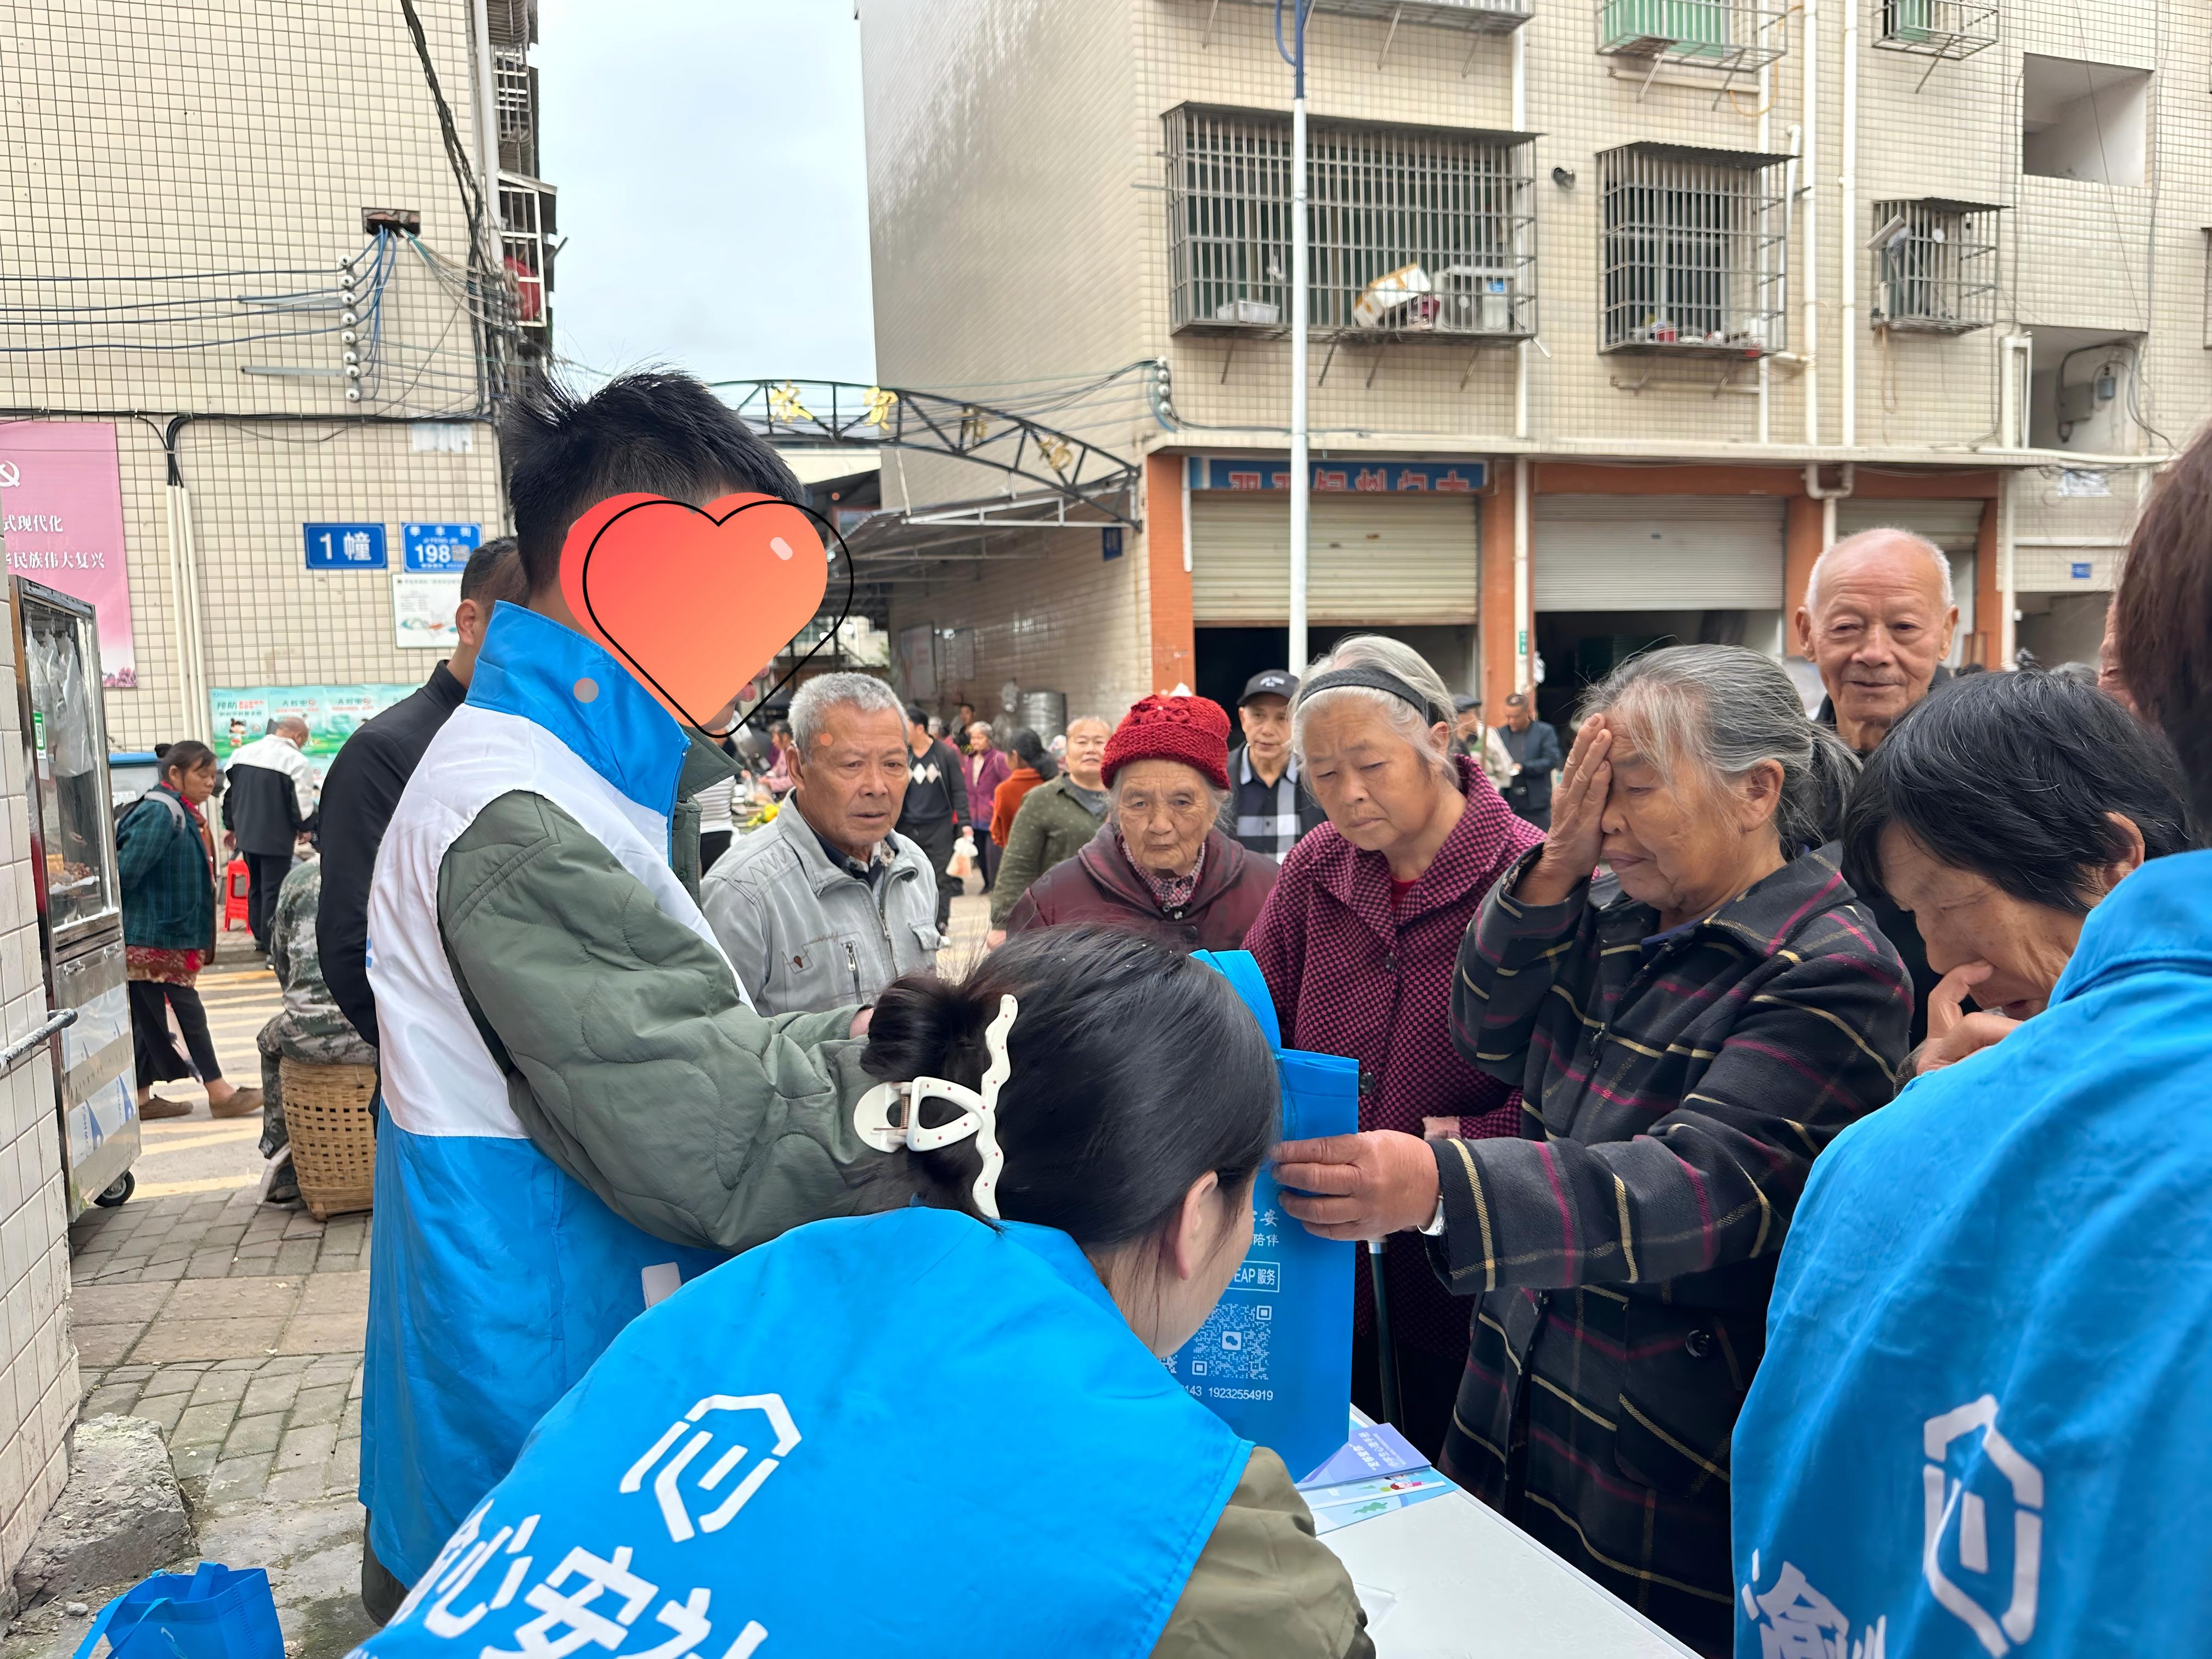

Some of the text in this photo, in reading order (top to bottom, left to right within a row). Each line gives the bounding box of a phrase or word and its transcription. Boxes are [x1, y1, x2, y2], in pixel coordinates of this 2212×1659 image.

[4, 514, 64, 532] 式现代化
[415, 544, 451, 563] 198
[1253, 1209, 1278, 1227] 安
[1253, 1233, 1279, 1247] 陪伴
[1234, 1267, 1276, 1285] EAP 服务
[1180, 1384, 1273, 1401] 143 19232554919
